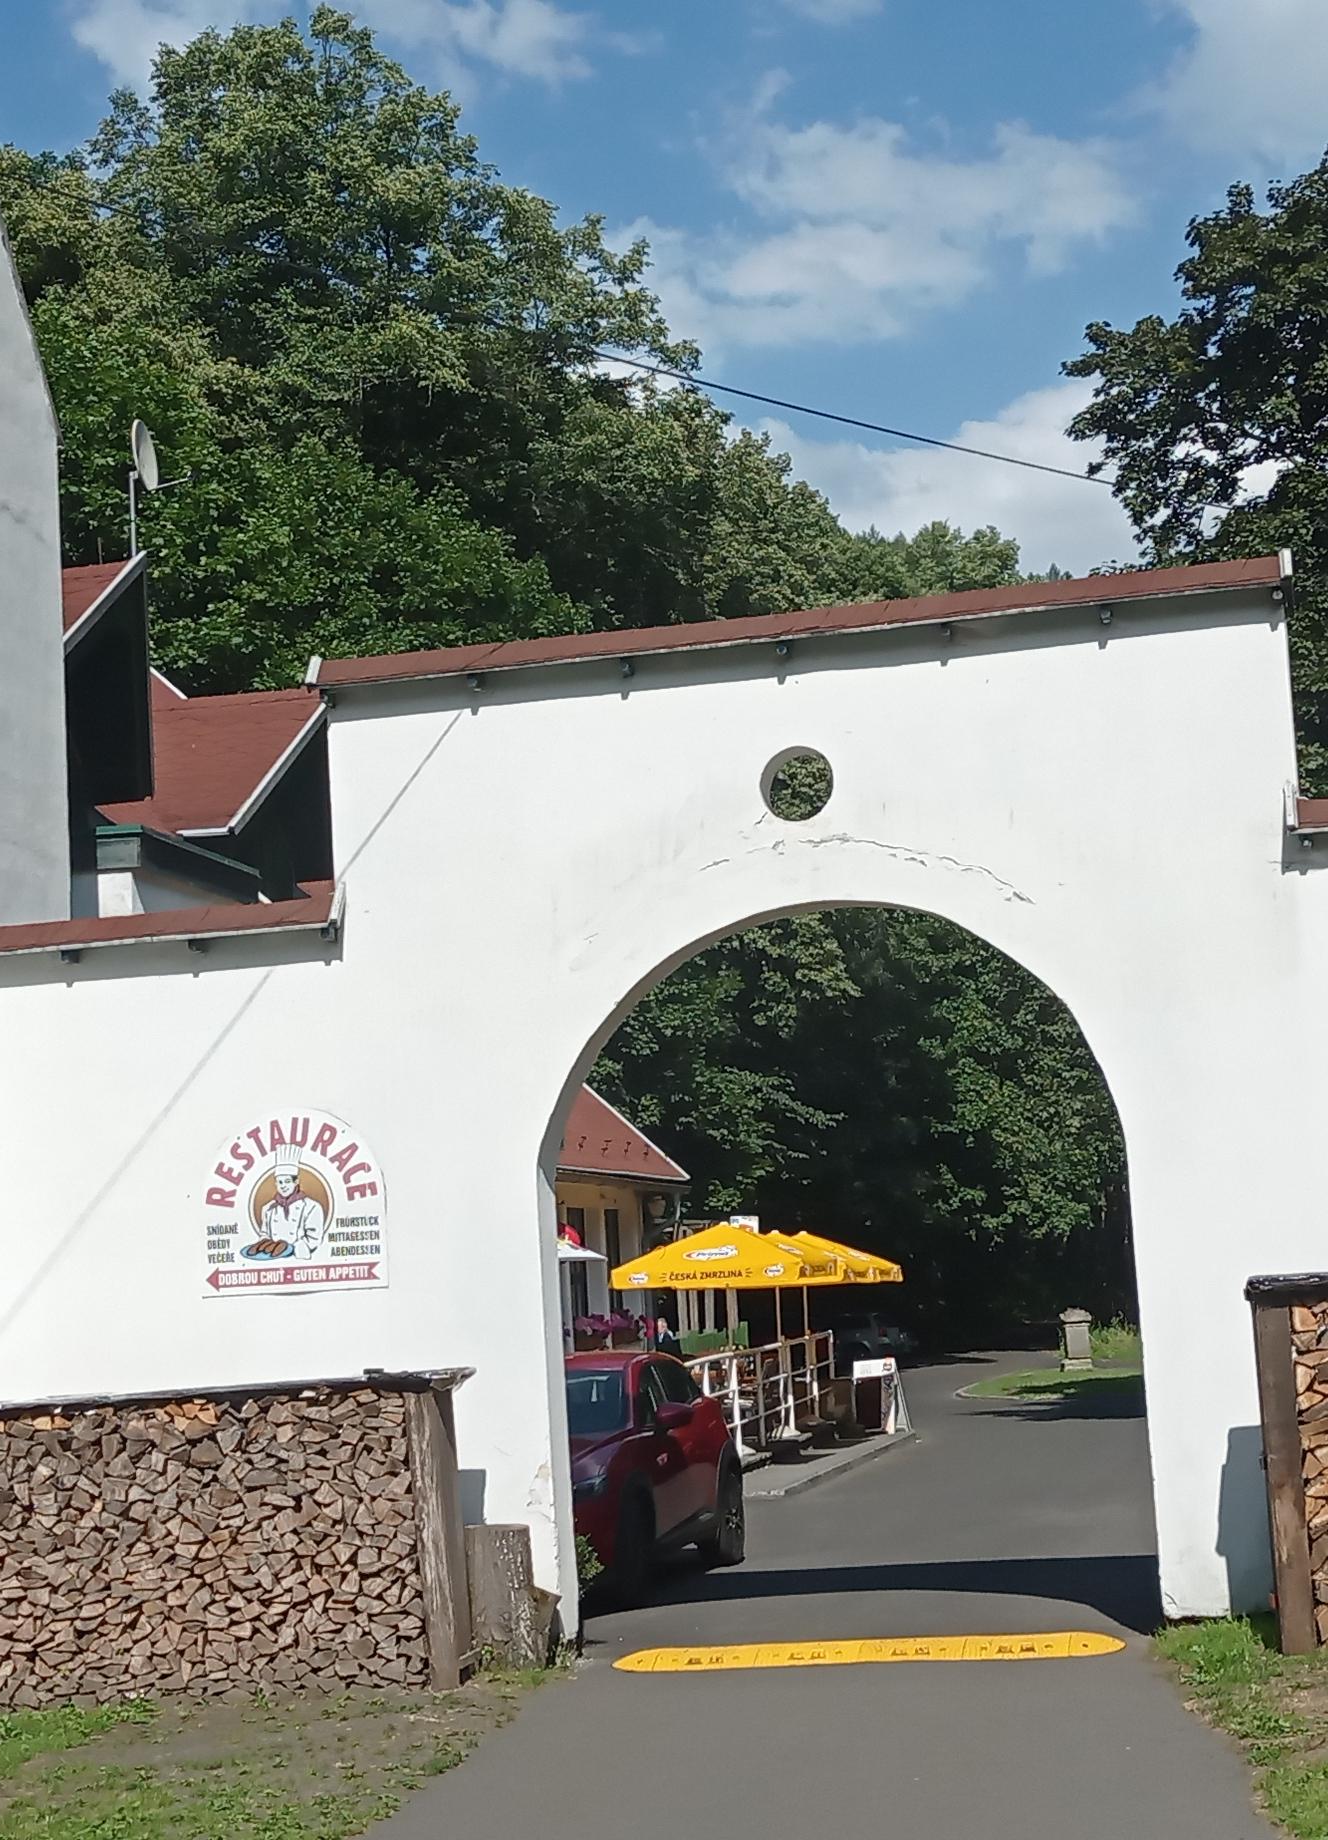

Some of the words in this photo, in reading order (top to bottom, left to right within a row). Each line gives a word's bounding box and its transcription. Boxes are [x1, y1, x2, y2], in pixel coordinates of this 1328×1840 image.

[205, 1117, 378, 1208] RESTAURACE
[328, 1230, 380, 1242] MITTAGESSEN
[330, 1244, 380, 1257] ABENDESSEN
[218, 1271, 257, 1286] DOBROU
[260, 1267, 285, 1283] CHUŤ
[293, 1267, 326, 1281] GUTEN
[328, 1265, 369, 1280] APPETIT
[669, 1270, 697, 1281] ČESKÁ
[700, 1269, 743, 1280] ZMRZLINA
